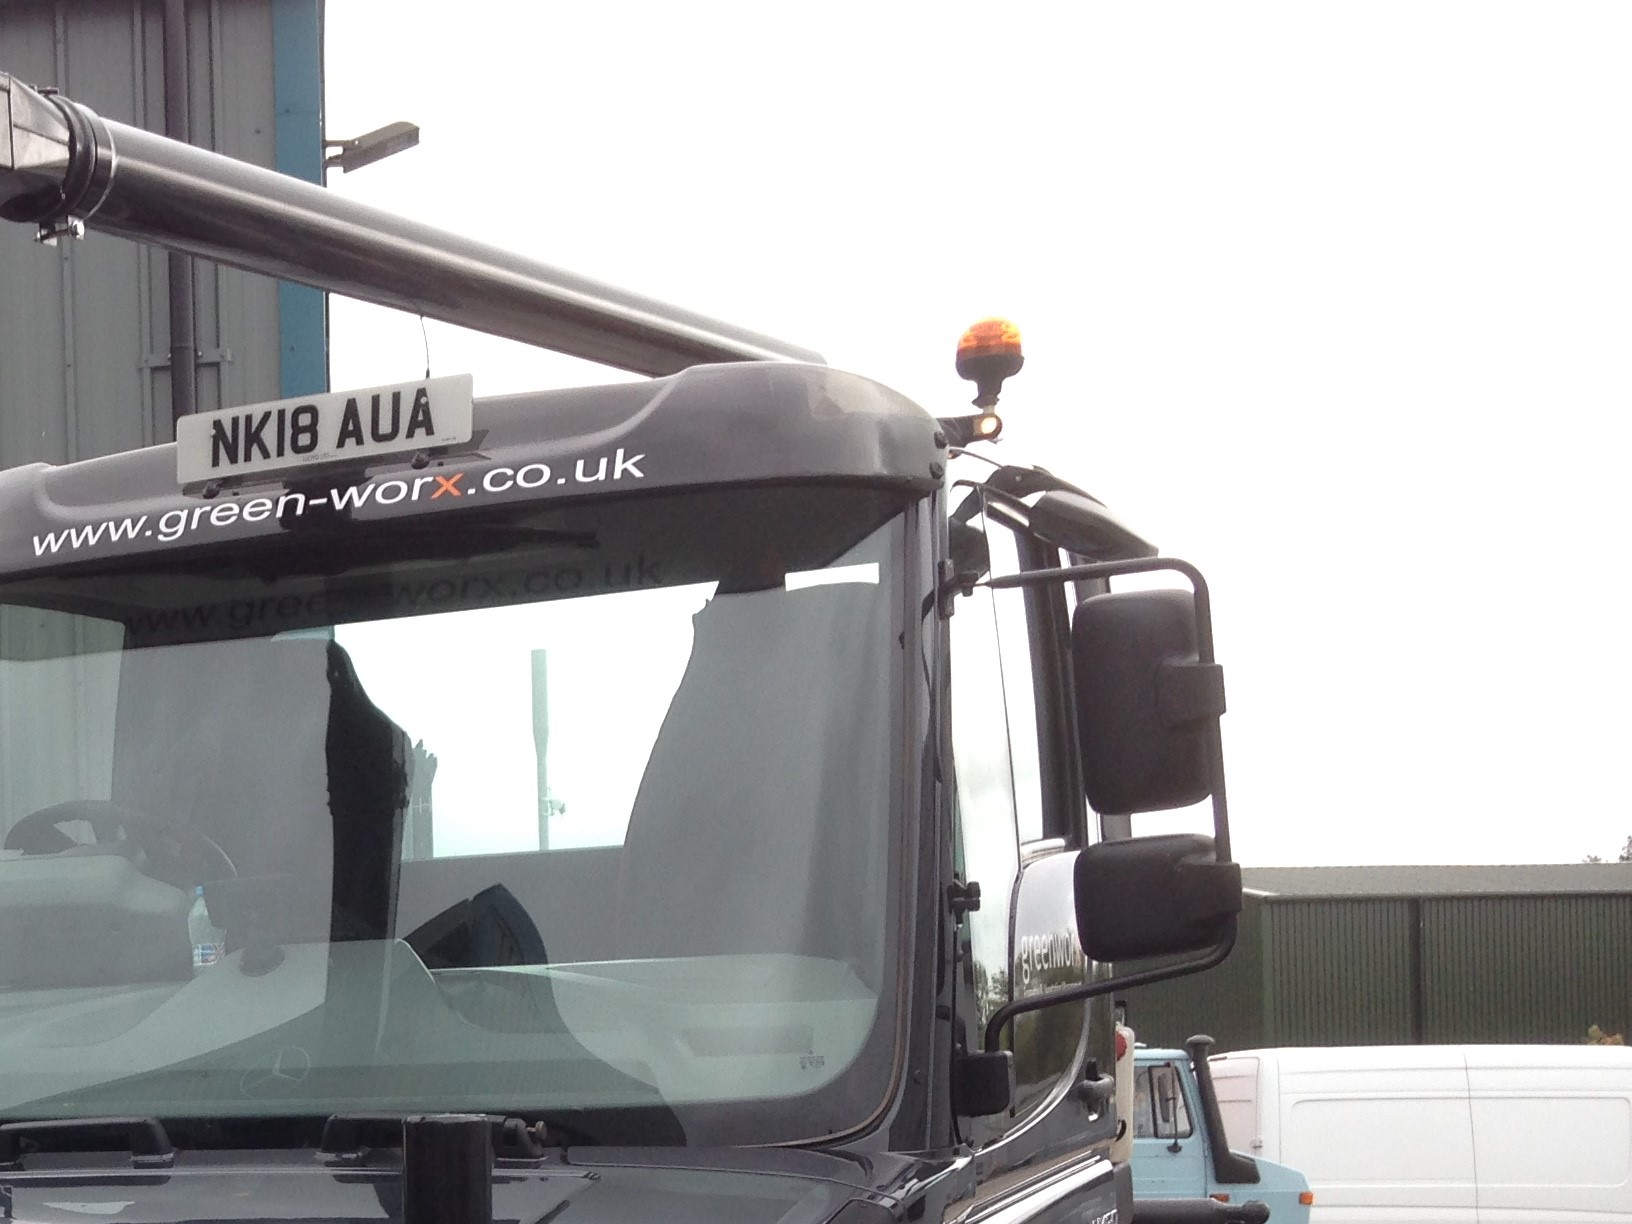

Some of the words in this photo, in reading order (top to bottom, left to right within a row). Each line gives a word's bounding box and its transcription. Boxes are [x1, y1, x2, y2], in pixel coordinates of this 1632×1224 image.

[209, 404, 320, 469] NK18
[335, 387, 436, 450] AUA
[31, 447, 647, 557] www.green-worx.co.uk
